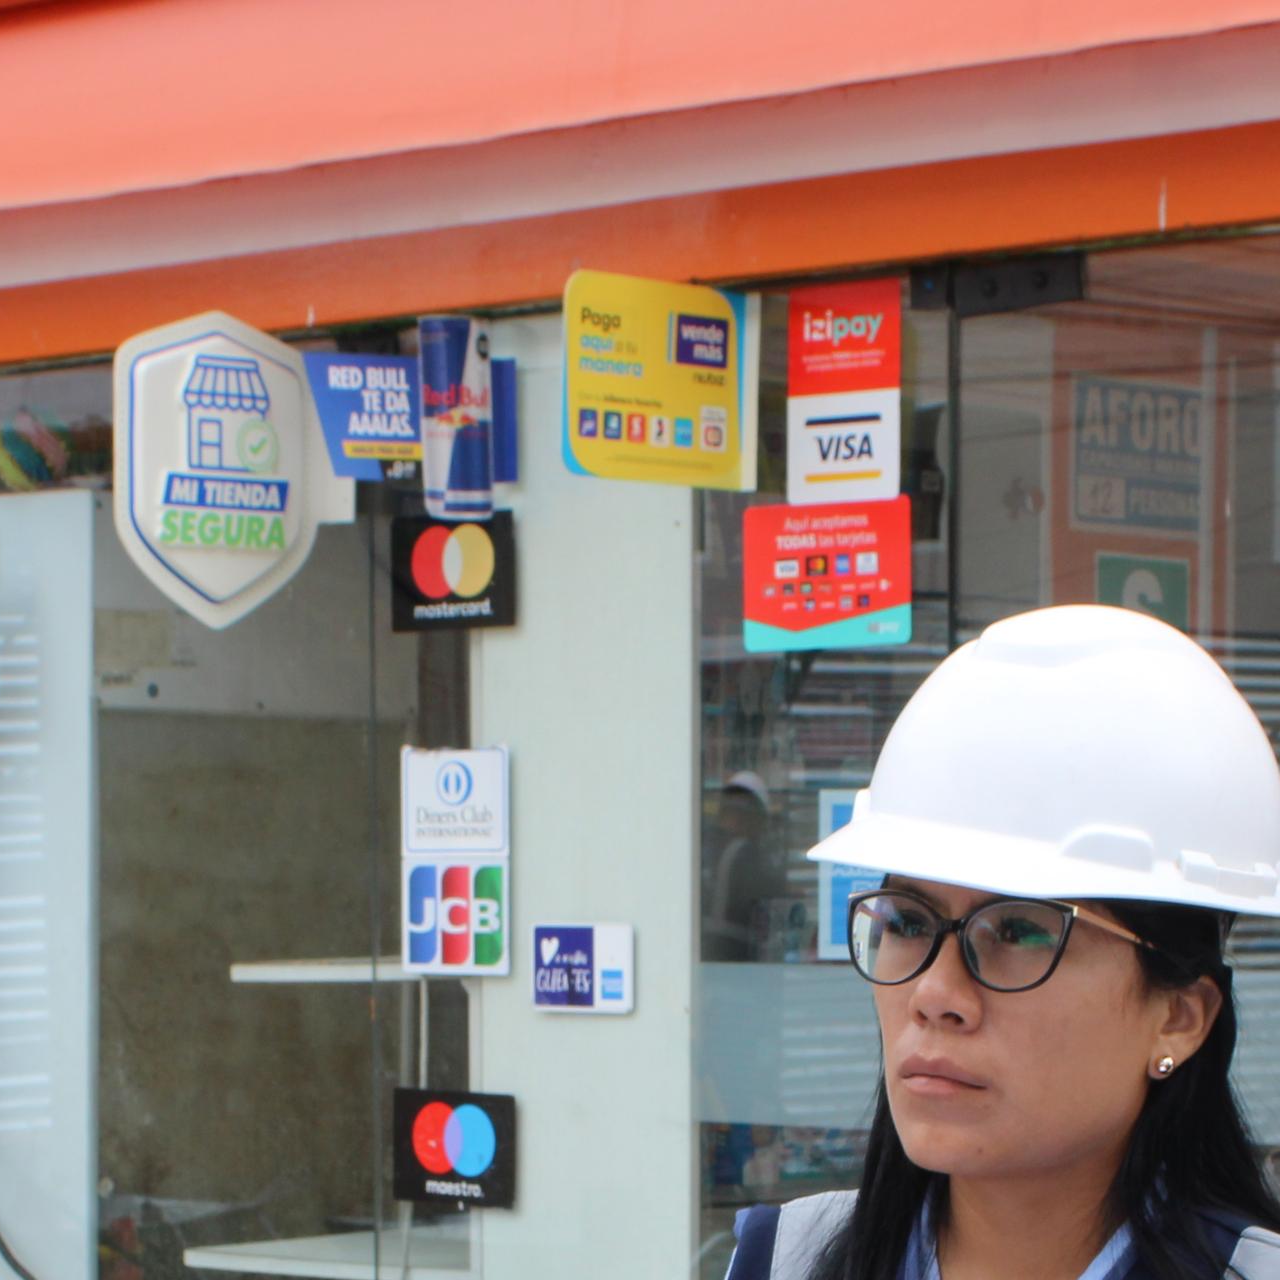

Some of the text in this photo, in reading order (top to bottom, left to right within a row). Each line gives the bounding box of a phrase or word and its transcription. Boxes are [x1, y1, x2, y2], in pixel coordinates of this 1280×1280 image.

[581, 307, 621, 331] Paga
[803, 309, 883, 346] izipay
[681, 325, 724, 344] vende
[328, 366, 408, 390] RED BULL
[579, 357, 643, 378] manera
[362, 389, 410, 413] TE DA
[423, 383, 456, 406] Red
[814, 434, 874, 463] VISA
[171, 477, 281, 511] MI TIENDA
[160, 508, 286, 551] SEGURA
[811, 515, 868, 530] aceptamos
[777, 534, 816, 549] TODAS
[836, 533, 877, 549] tarjetas
[414, 601, 491, 620] mastercard
[416, 804, 493, 825] Diners Club
[409, 897, 501, 934] JCB
[426, 1180, 481, 1198] maestro
